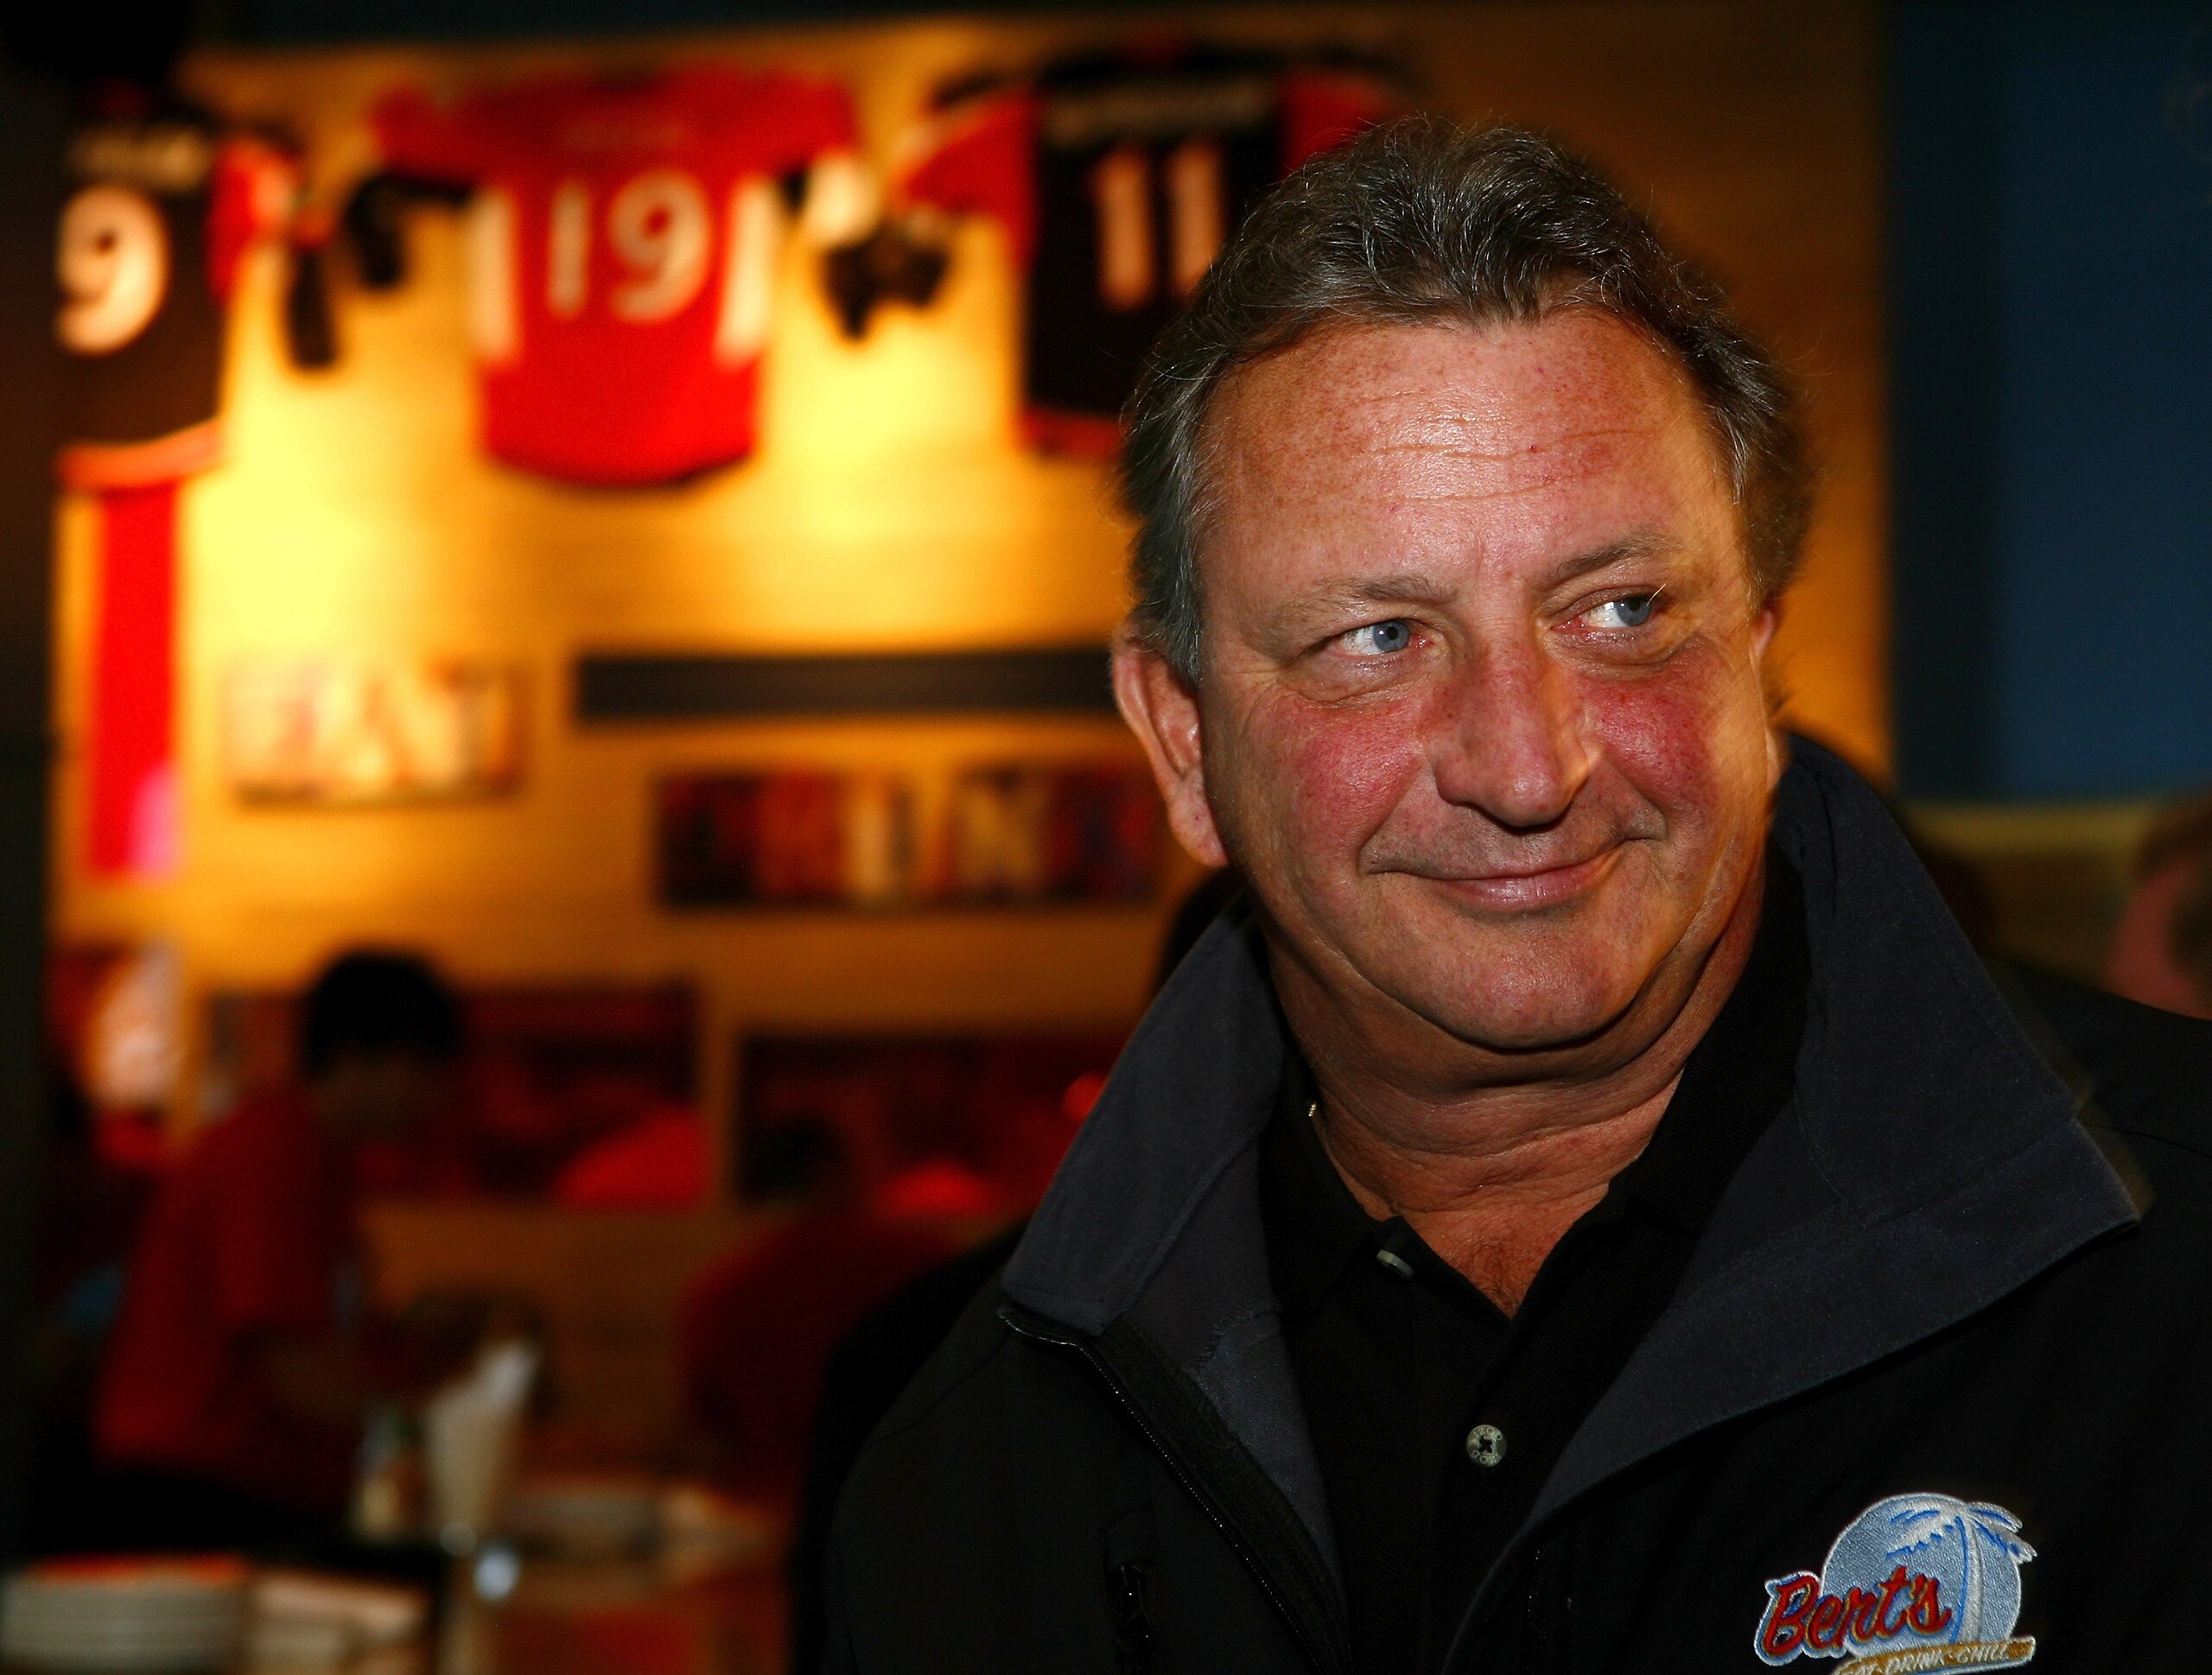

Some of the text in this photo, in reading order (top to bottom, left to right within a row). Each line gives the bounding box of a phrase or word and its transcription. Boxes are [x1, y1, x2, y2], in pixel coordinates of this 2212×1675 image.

[548, 172, 711, 321] 19
[1095, 136, 1223, 310] 11
[1761, 1565, 1953, 1656] Bert's
